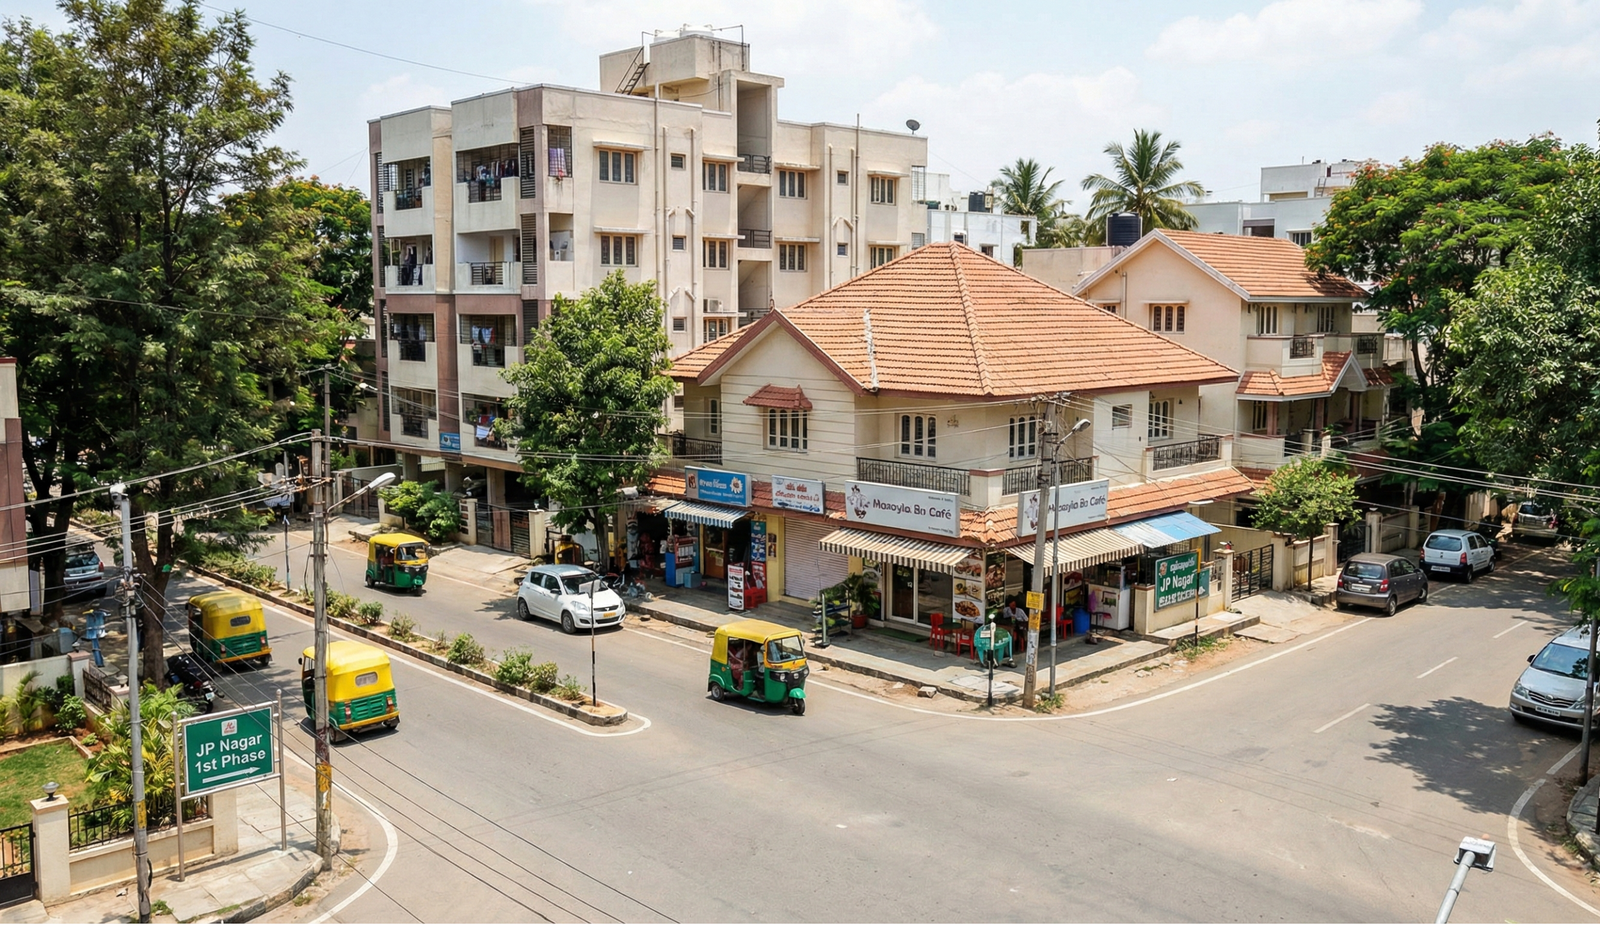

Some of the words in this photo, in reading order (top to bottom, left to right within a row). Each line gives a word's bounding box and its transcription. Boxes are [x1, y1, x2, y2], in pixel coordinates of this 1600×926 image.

[1089, 494, 1106, 506] Café
[929, 507, 952, 520] Café
[1160, 577, 1171, 592] JP
[1172, 573, 1195, 589] Nagar
[196, 742, 215, 757] JP
[219, 734, 263, 752] Nagar
[195, 758, 218, 773] 1st
[221, 750, 266, 768] Phase
